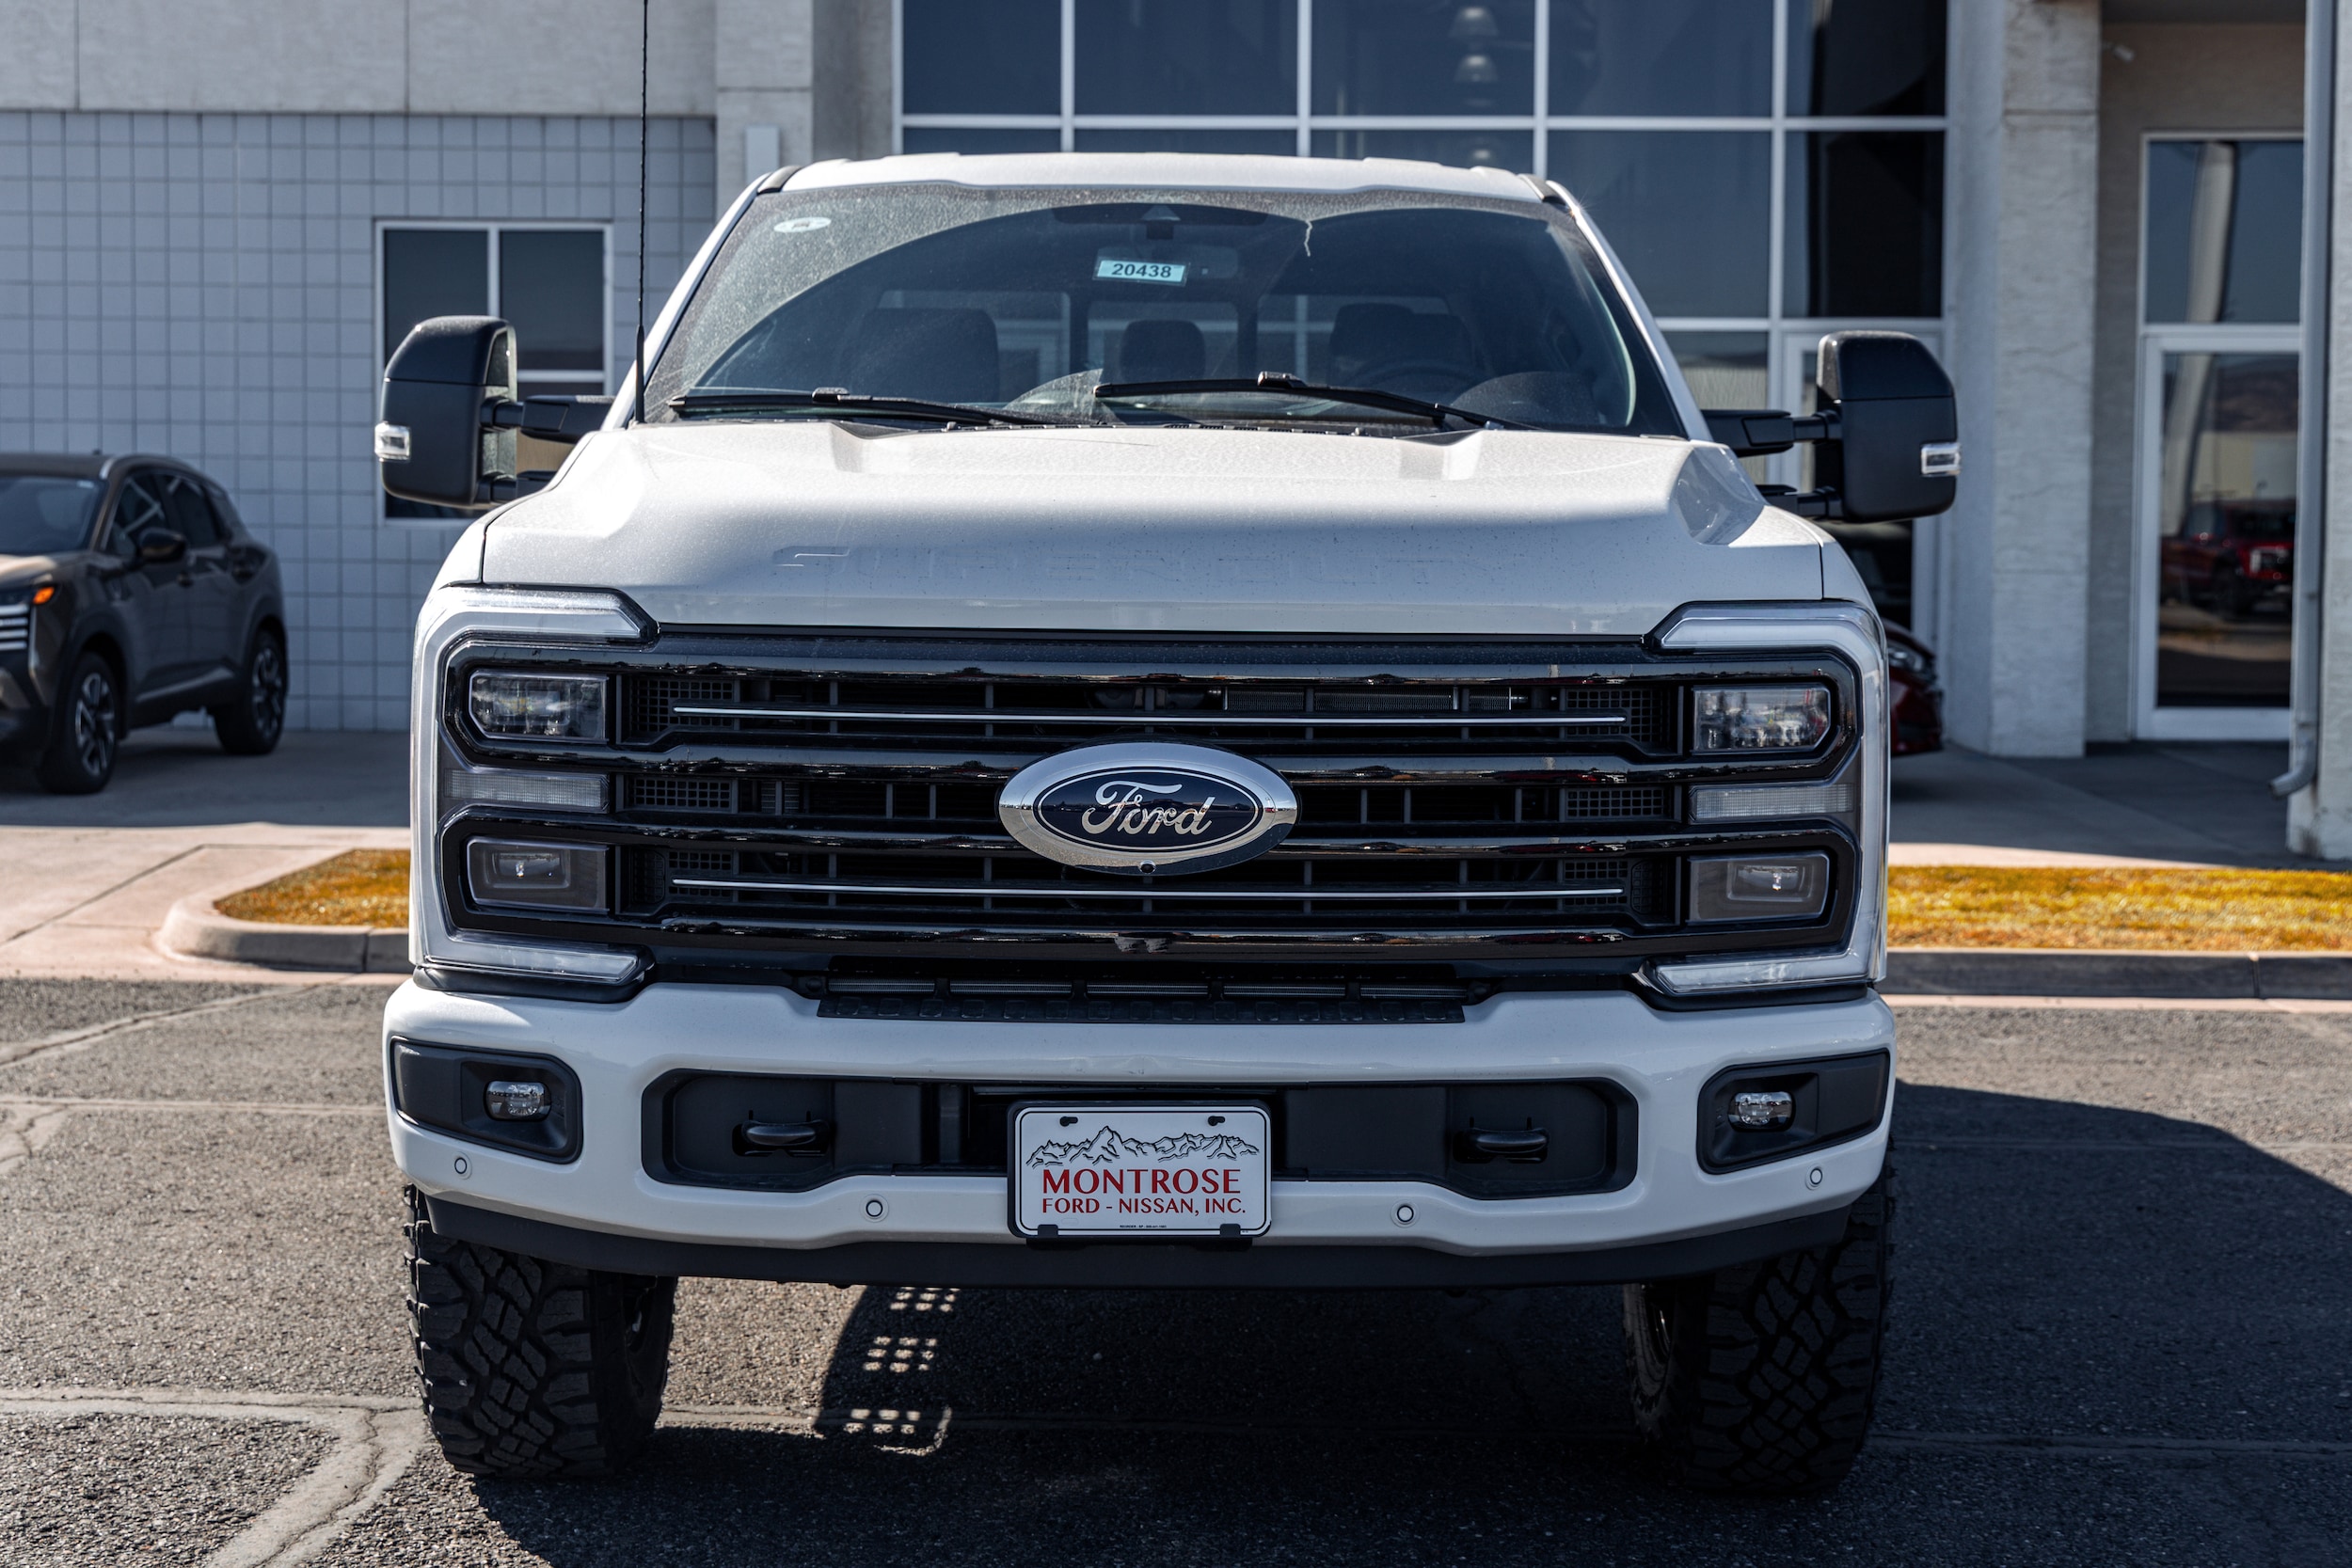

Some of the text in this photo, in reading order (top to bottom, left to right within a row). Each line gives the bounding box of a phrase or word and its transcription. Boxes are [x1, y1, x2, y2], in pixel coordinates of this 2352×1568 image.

[1111, 263, 1172, 278] 20438
[1082, 781, 1216, 835] Ford
[1042, 1168, 1241, 1195] MONTROSE
[1042, 1198, 1101, 1213] FORD
[1119, 1198, 1200, 1216] NISSAN,
[1205, 1198, 1247, 1213] INC.
